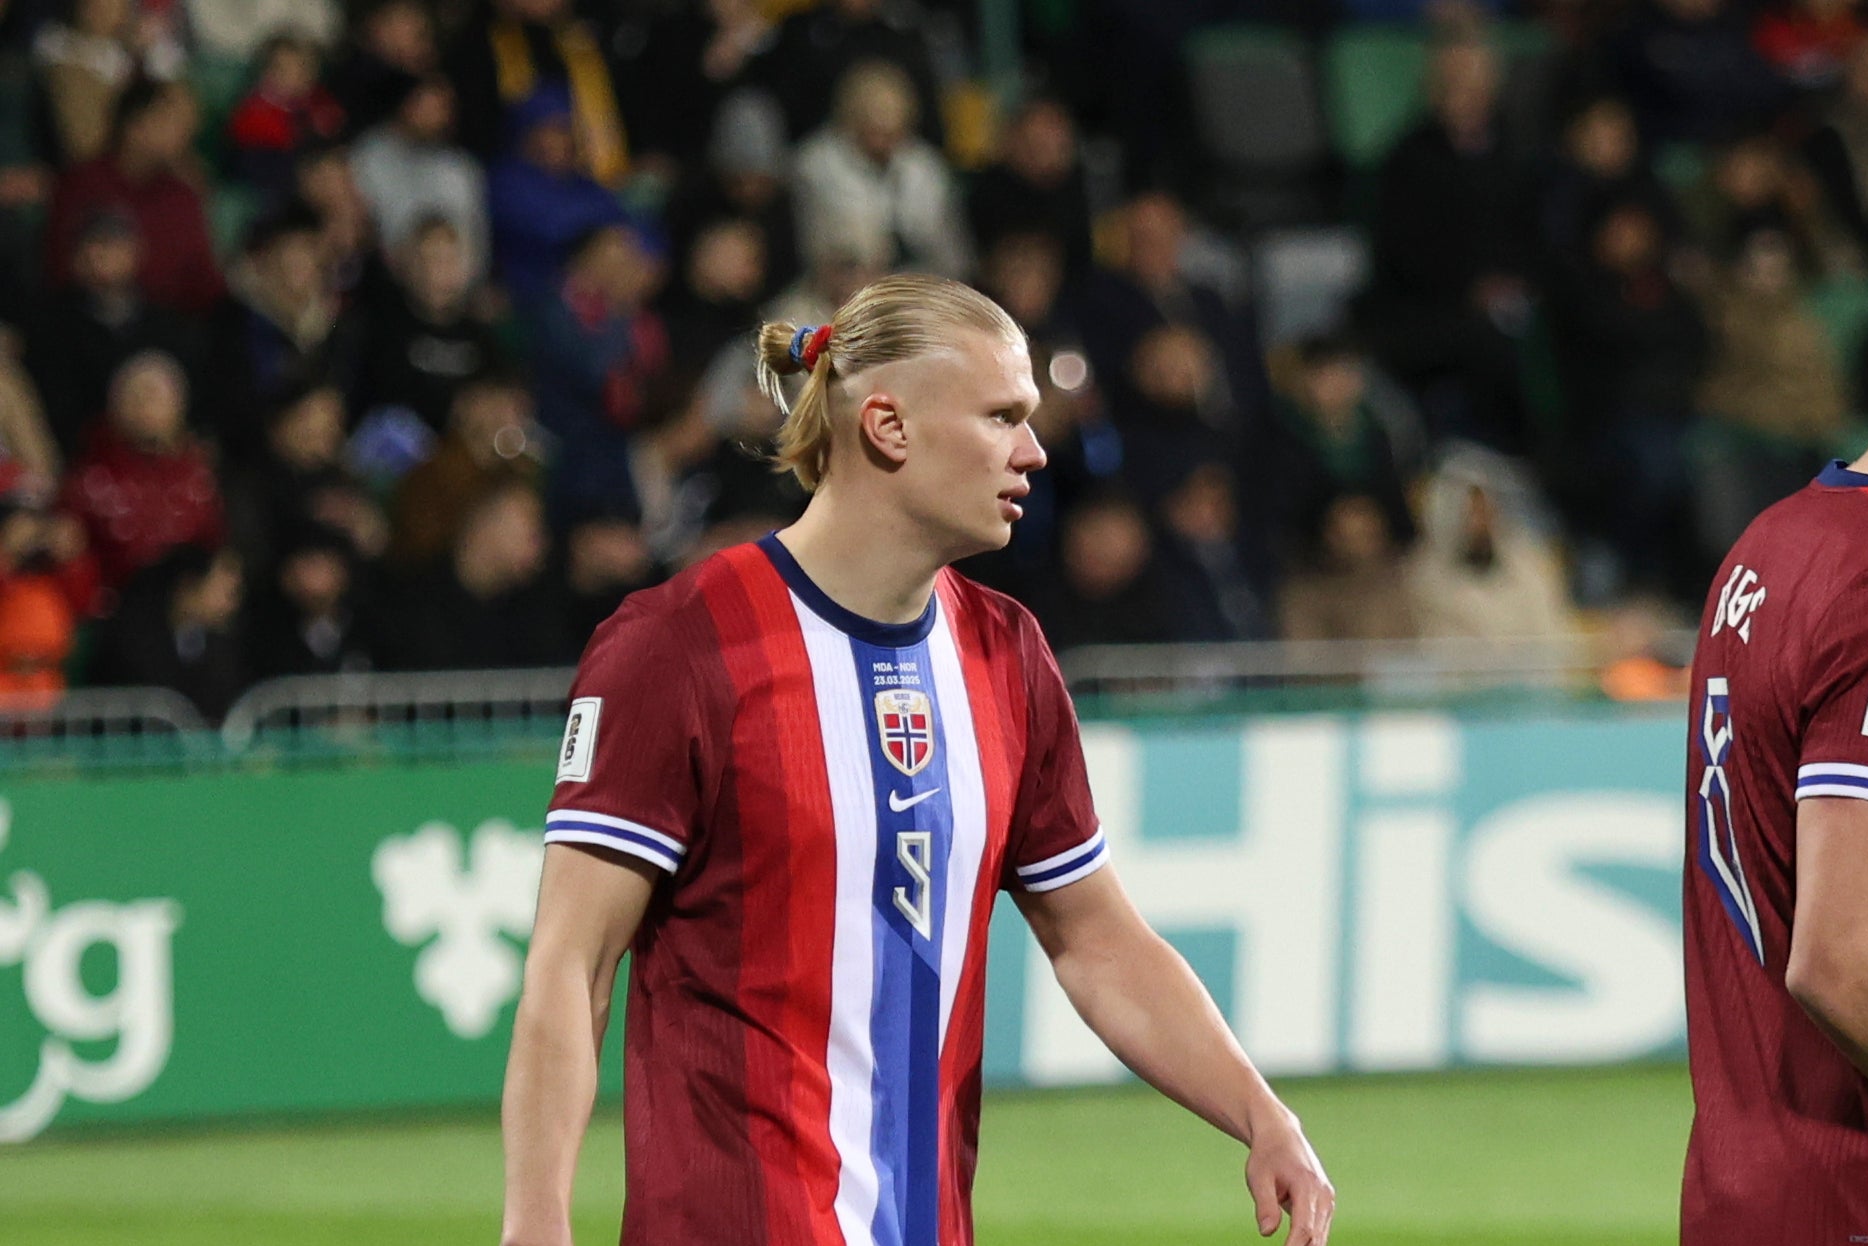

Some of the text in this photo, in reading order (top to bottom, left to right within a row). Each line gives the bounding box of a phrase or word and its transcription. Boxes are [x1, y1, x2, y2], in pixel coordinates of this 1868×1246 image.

[873, 663, 893, 672] MDA
[900, 663, 917, 672] NOR
[892, 831, 931, 942] 9
